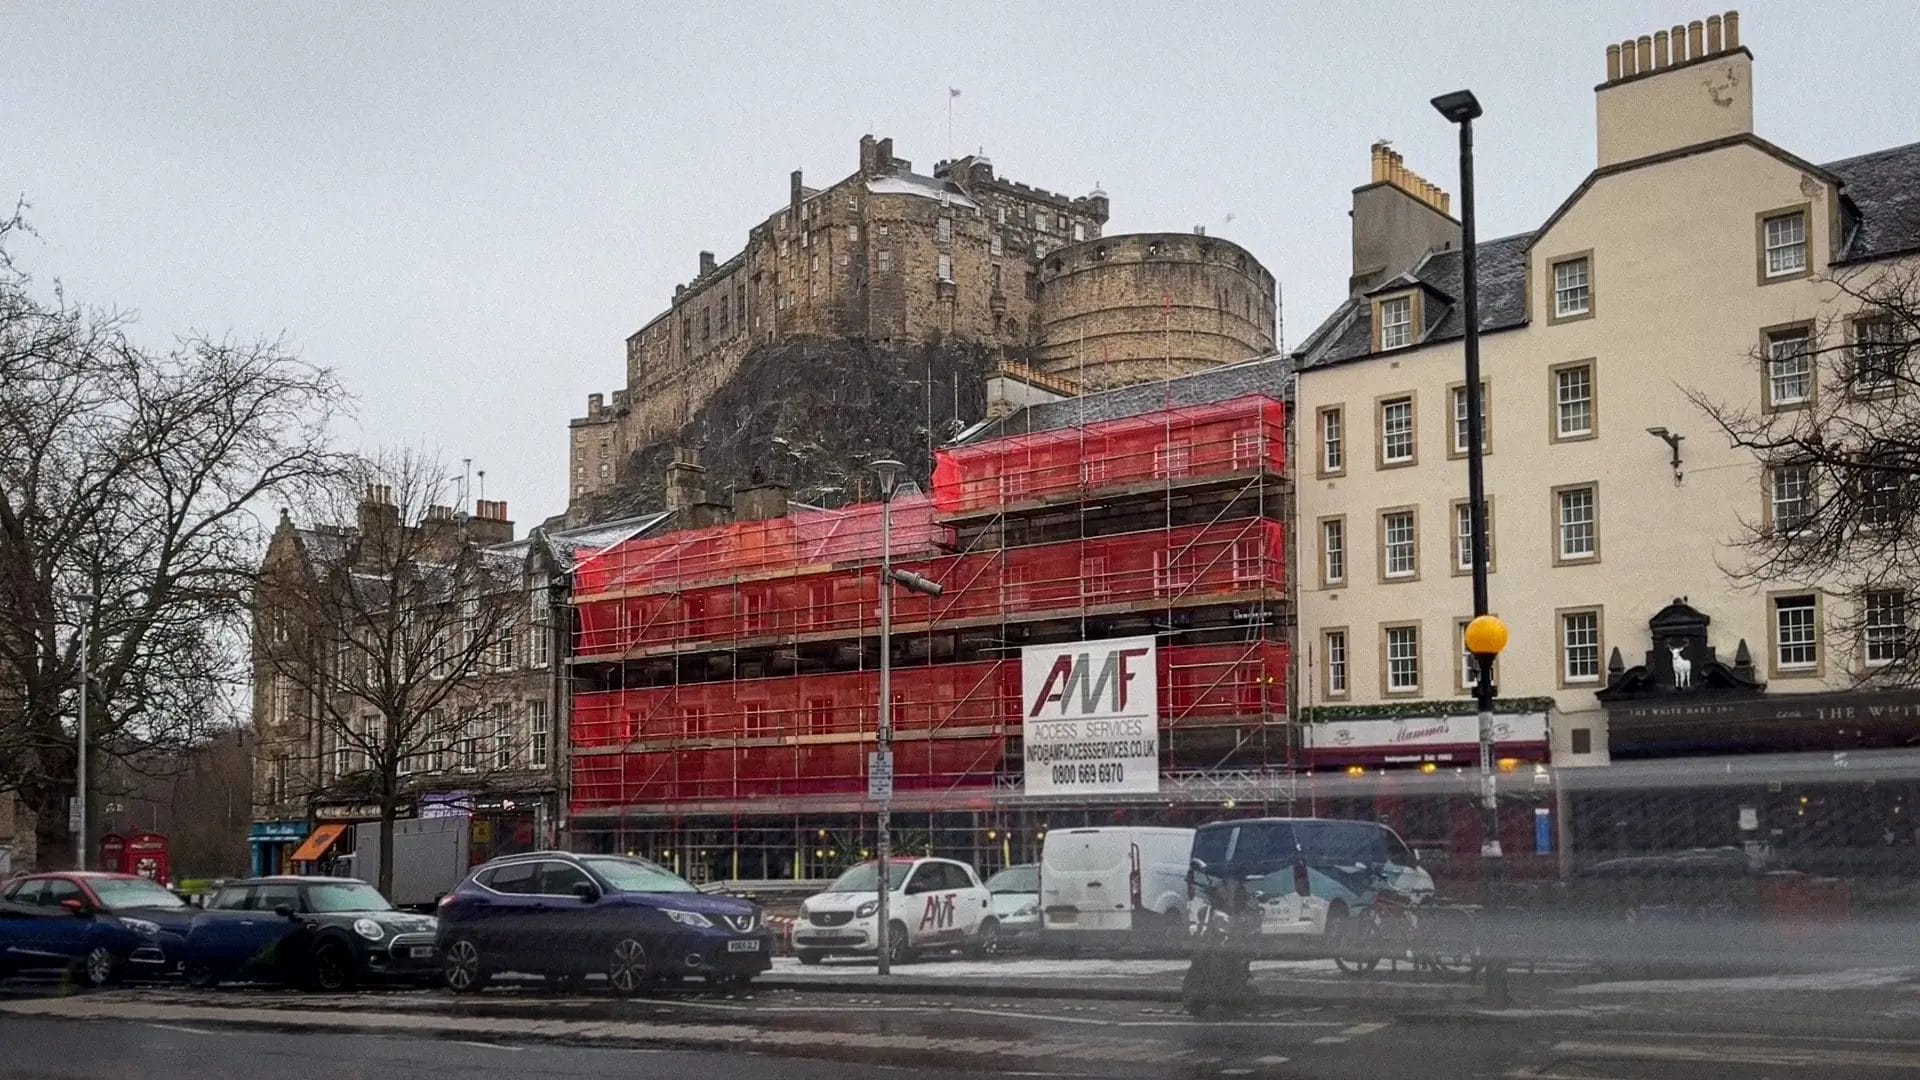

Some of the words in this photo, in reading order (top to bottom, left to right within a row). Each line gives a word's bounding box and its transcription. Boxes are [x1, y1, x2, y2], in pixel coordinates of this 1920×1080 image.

[1029, 648, 1149, 717] AMF
[1816, 707, 1856, 720] THE
[1035, 723, 1078, 740] ACCESS
[1086, 720, 1143, 738] SERVICES
[1052, 765, 1076, 784] 0800
[1078, 764, 1096, 784] 669
[1099, 763, 1123, 783] 6970
